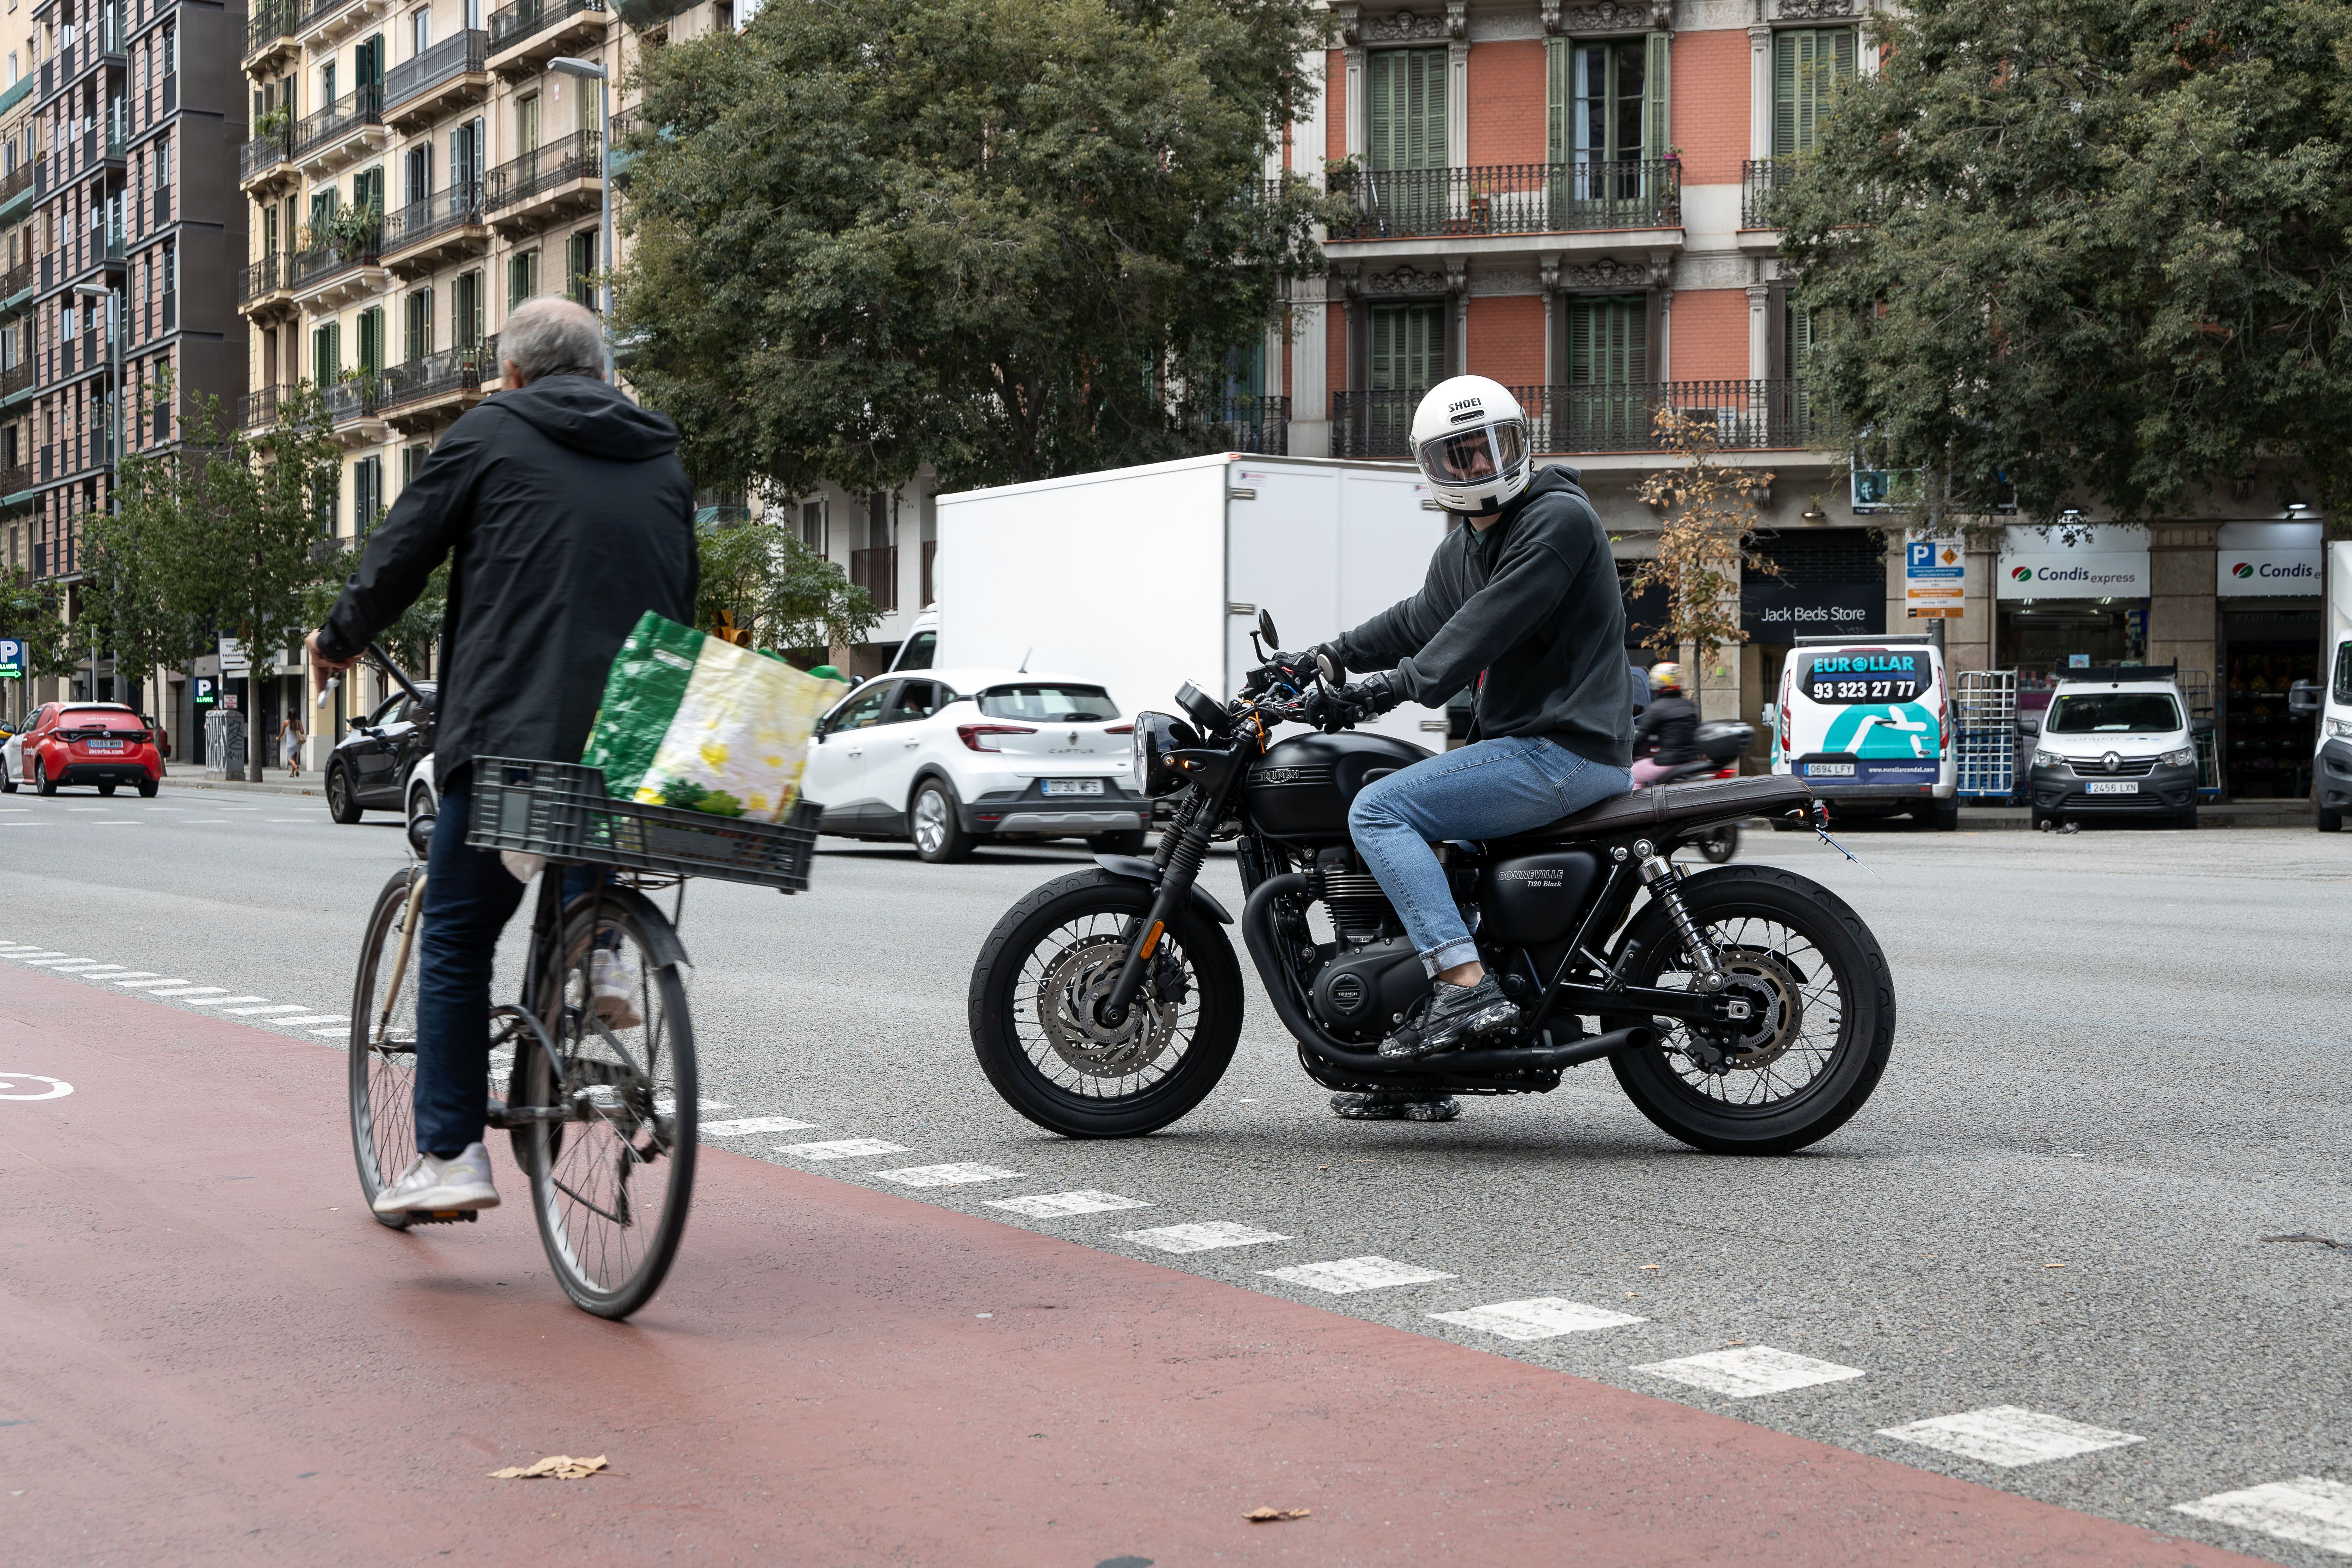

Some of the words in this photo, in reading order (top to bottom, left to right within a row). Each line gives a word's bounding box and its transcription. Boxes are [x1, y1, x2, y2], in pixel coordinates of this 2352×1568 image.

[1448, 397, 1481, 413] SHOEI
[1913, 546, 1929, 565] P
[2038, 566, 2089, 581] Condis
[2090, 574, 2135, 585] express
[2259, 563, 2312, 577] Condis
[1761, 606, 1792, 621] Jack
[1795, 606, 1828, 621] Beds
[1830, 606, 1866, 621] Store
[0, 641, 18, 663] P
[1814, 656, 1915, 673] EUROLLAR
[198, 680, 211, 696] P
[1814, 683, 1833, 699] 93
[1838, 682, 1867, 698] 323
[1872, 681, 1891, 697] 27
[1896, 681, 1916, 697] 77
[1260, 769, 1299, 783] TRIUMPH
[1811, 765, 1831, 773] 0694
[1835, 765, 1851, 773] LFY
[1498, 870, 1563, 880] BONNEVILLE
